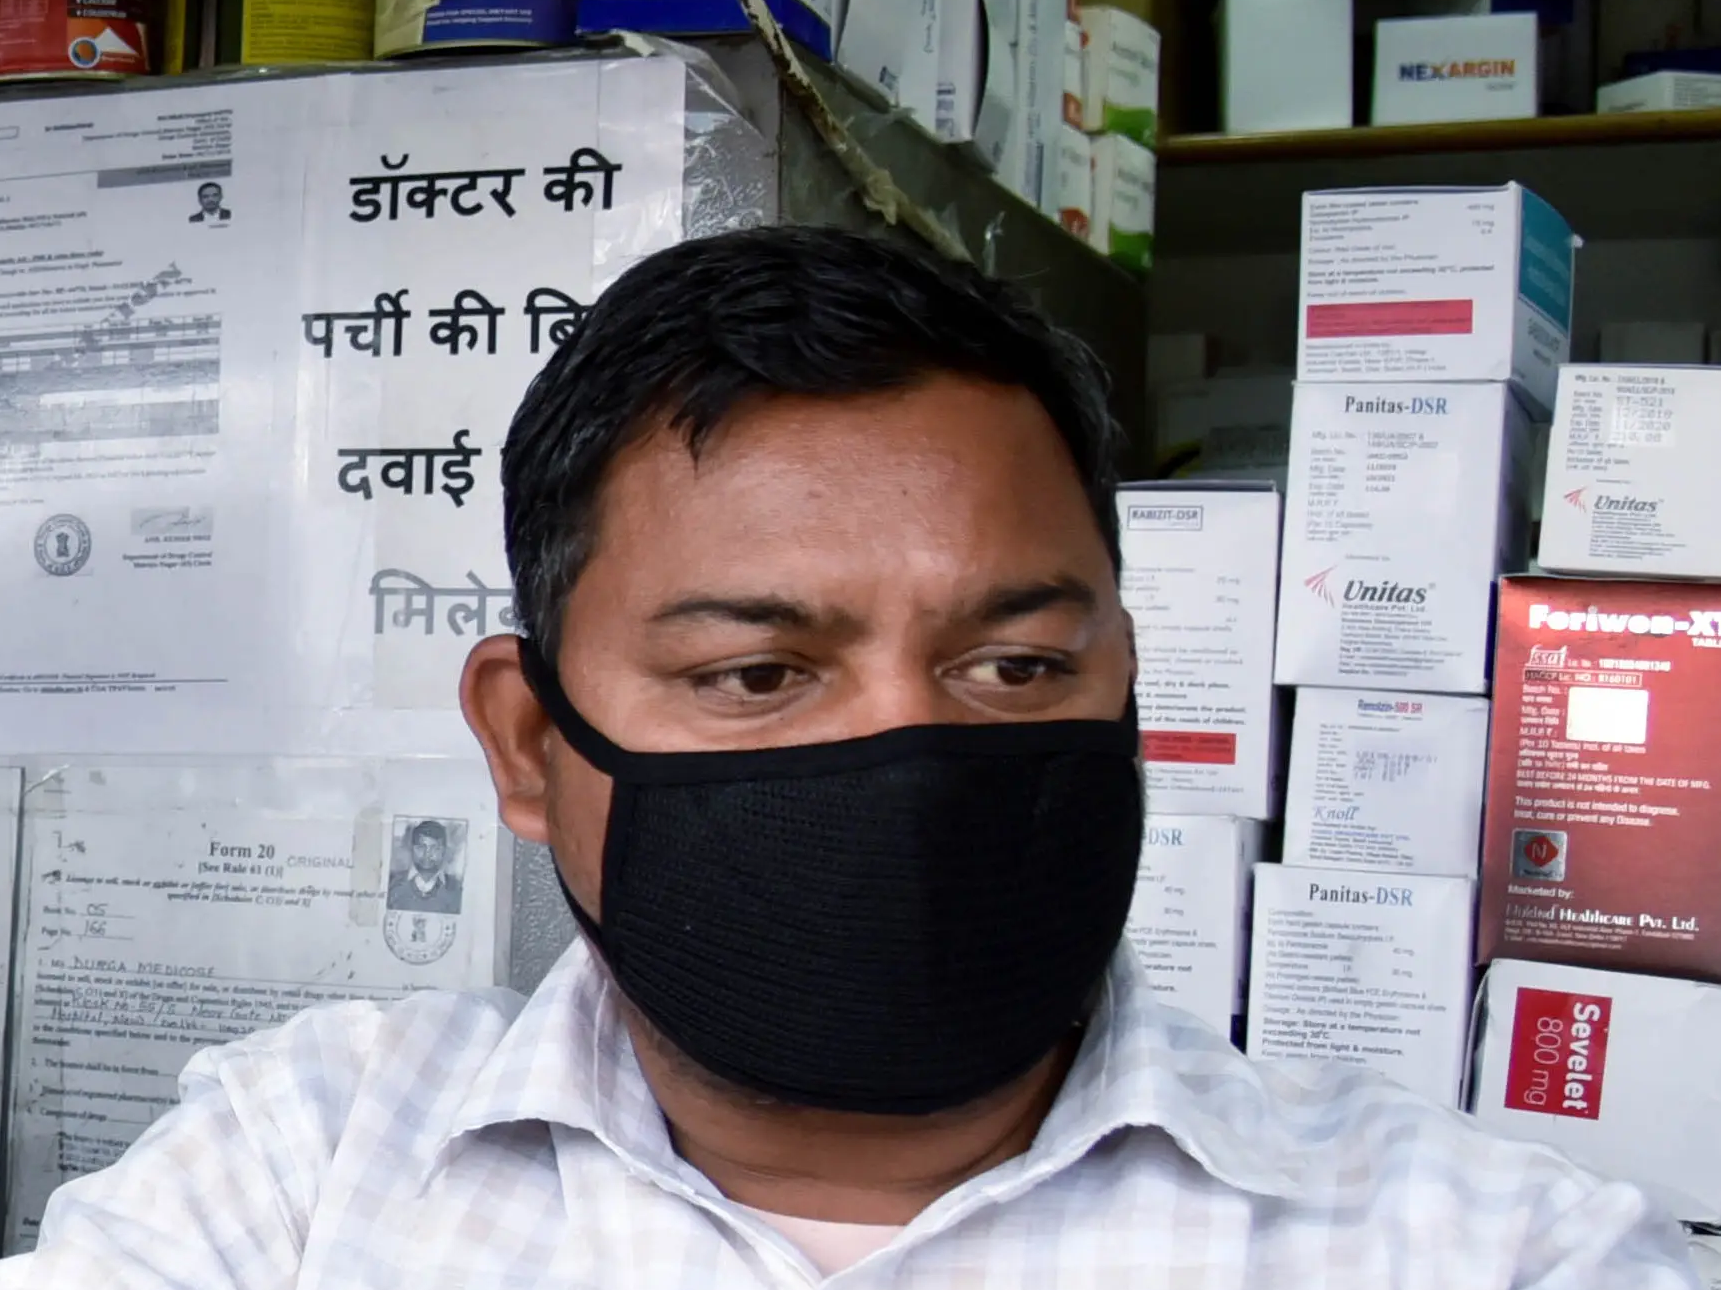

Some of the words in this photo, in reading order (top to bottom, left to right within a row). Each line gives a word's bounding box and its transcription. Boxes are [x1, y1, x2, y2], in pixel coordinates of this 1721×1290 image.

[1398, 57, 1516, 83] NEXARGIN
[348, 153, 525, 224] डॉक्टर
[543, 147, 623, 213] की
[301, 288, 411, 359] पर्ची
[428, 288, 505, 356] की
[1344, 394, 1449, 416] Panitas-DSR
[336, 430, 481, 507] दवाई
[1593, 494, 1659, 513] Unitas
[1341, 579, 1428, 604] Unitas
[208, 841, 253, 860] Form
[256, 843, 276, 860] 20
[286, 854, 355, 870] ORIGINAL
[1308, 882, 1415, 907] Panitas-DSR
[1535, 1014, 1565, 1066] 800
[1561, 1001, 1602, 1115] Sevelet
[1523, 1068, 1551, 1107] mg
